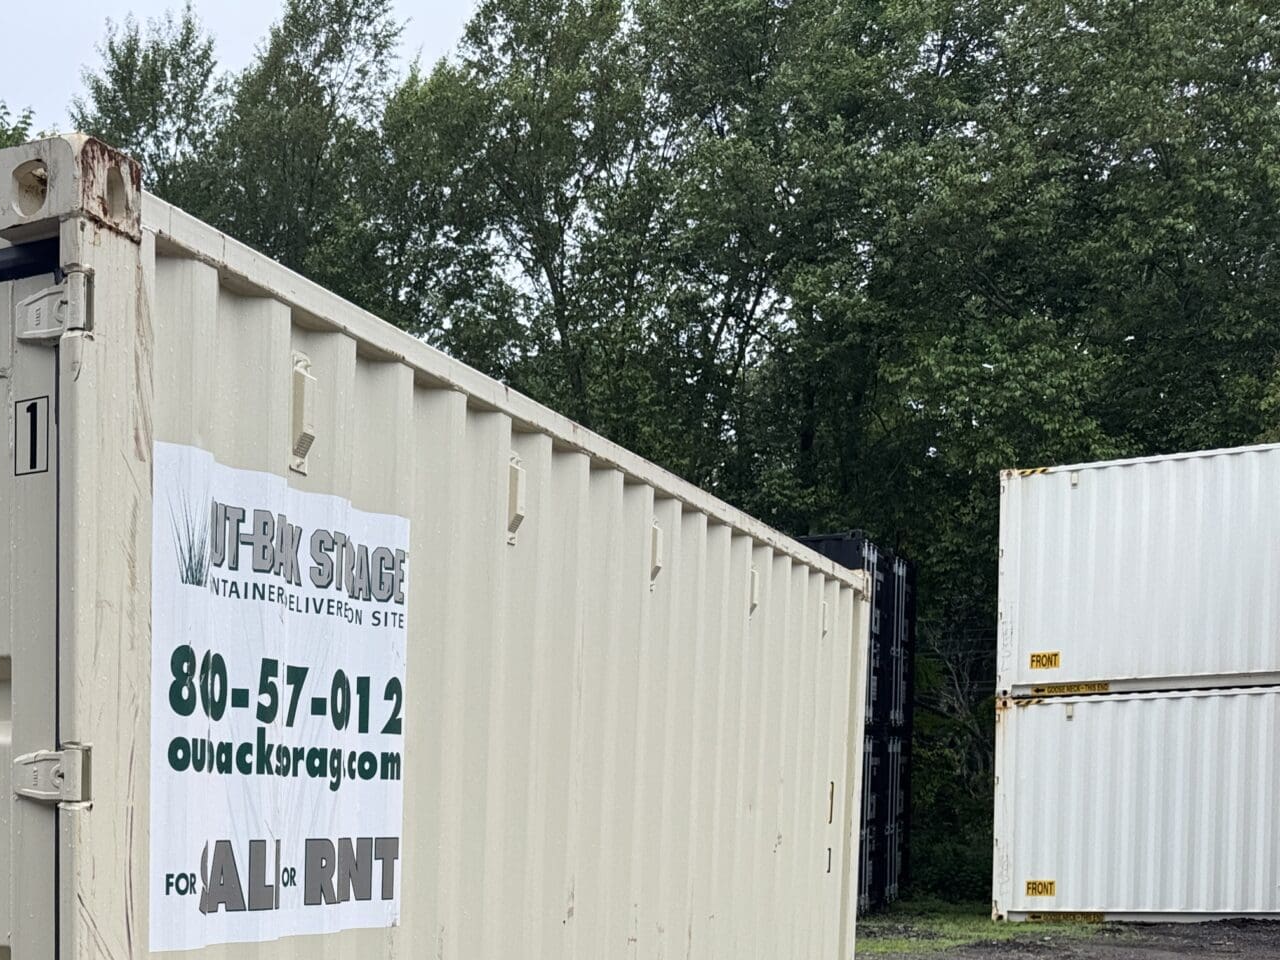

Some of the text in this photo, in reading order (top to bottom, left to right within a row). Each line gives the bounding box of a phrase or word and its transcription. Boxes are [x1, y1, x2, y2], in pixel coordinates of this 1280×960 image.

[26, 401, 38, 470] 1
[210, 500, 405, 605] UT-BAK STRAGE
[210, 575, 284, 604] NTAINER
[284, 593, 348, 618] ELIVERE
[371, 610, 404, 629] SITE
[1030, 653, 1059, 668] FRONT
[165, 872, 197, 896] FOR
[281, 866, 297, 888] OR
[304, 837, 399, 907] RNT
[1026, 881, 1054, 896] FRONT
